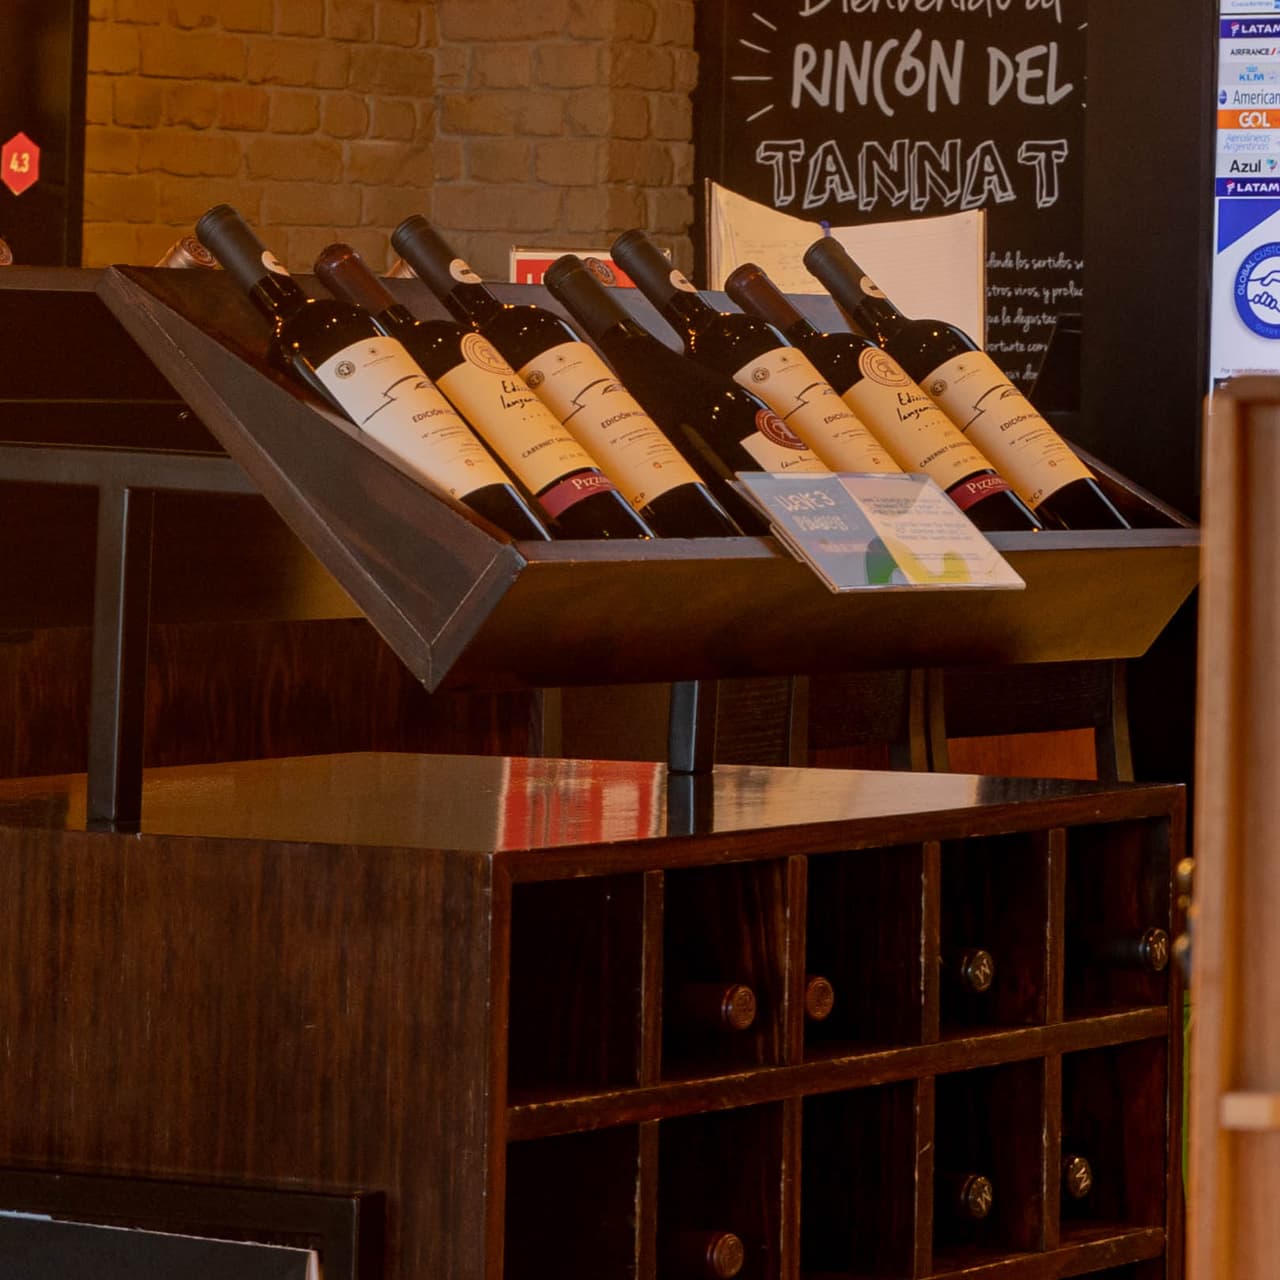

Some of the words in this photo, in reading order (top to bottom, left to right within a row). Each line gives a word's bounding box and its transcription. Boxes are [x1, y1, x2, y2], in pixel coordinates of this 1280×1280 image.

[790, 28, 965, 117] RINCÓN
[986, 41, 1074, 106] DEL
[1238, 73, 1265, 81] KLM
[1233, 89, 1280, 105] American
[1238, 111, 1271, 128] GOL
[1229, 160, 1262, 173] Azul
[1236, 183, 1280, 193] LATAM
[1237, 260, 1255, 296] GLOBAL
